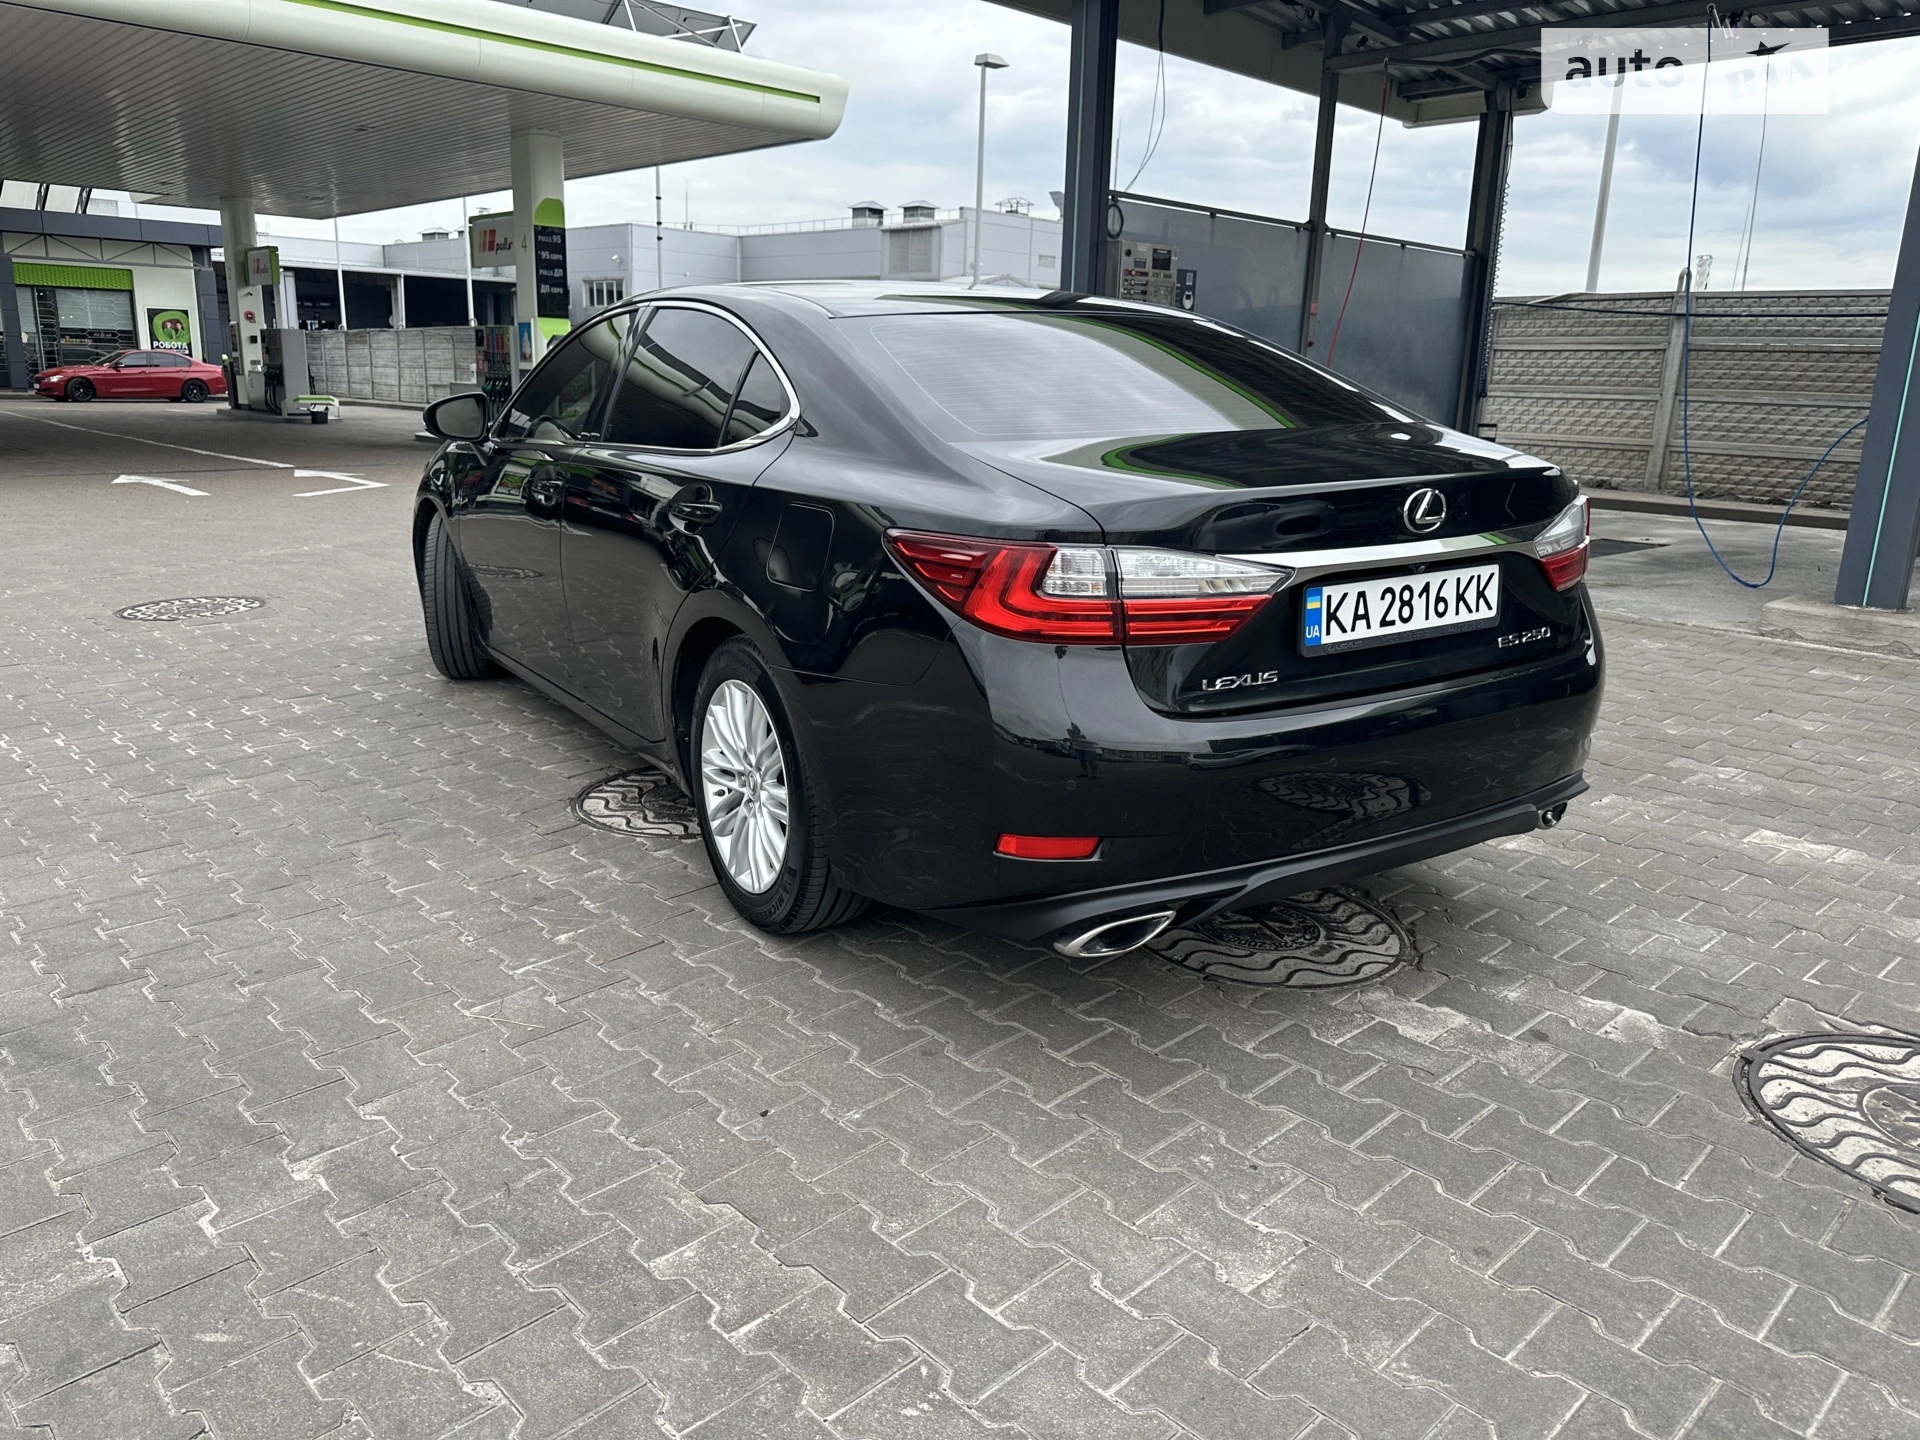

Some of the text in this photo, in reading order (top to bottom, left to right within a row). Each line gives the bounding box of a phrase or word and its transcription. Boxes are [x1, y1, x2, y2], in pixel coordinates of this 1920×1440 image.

[521, 234, 527, 252] 4
[152, 340, 189, 350] РОБОТА
[1324, 571, 1496, 637] KA 2816 KK
[1305, 624, 1321, 639] UA
[1497, 625, 1551, 649] ES 250
[1201, 669, 1279, 692] LEXUS
